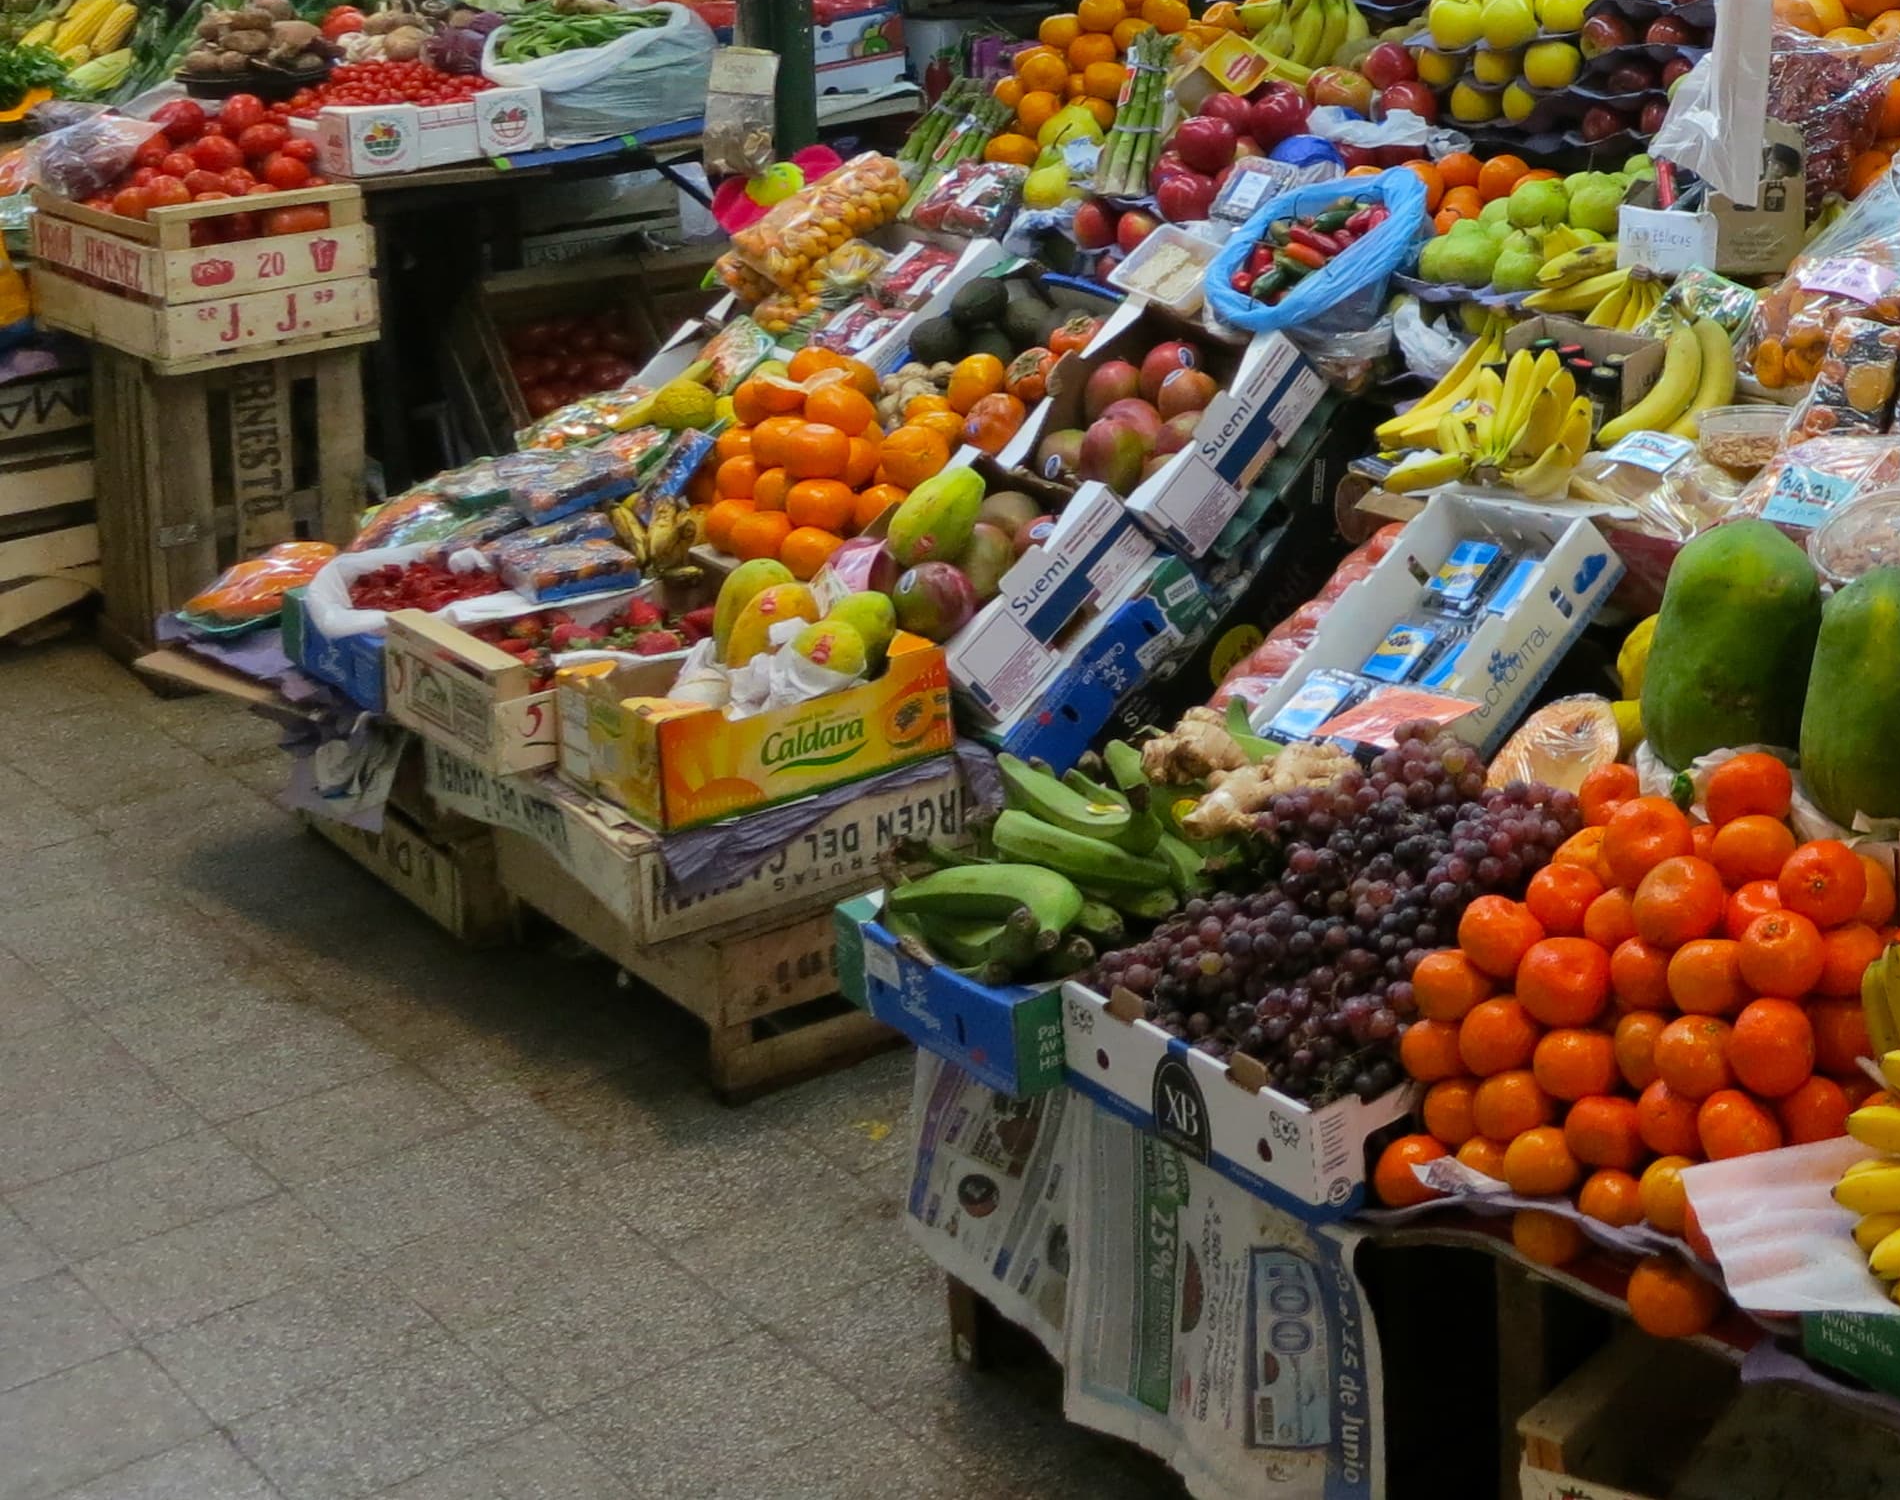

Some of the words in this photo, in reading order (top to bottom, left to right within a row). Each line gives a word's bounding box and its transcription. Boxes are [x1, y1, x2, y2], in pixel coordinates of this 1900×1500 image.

[85, 234, 143, 293] JIMENEZ
[257, 251, 286, 279] 20
[1011, 550, 1072, 618] Suemi
[760, 715, 866, 767] Caldara
[805, 821, 860, 860] DEL
[1162, 1082, 1199, 1137] XB
[1149, 1202, 1178, 1284] 25%
[1821, 1326, 1859, 1356] Hass
[1339, 1372, 1362, 1407] de
[1339, 1412, 1364, 1485] Junio
